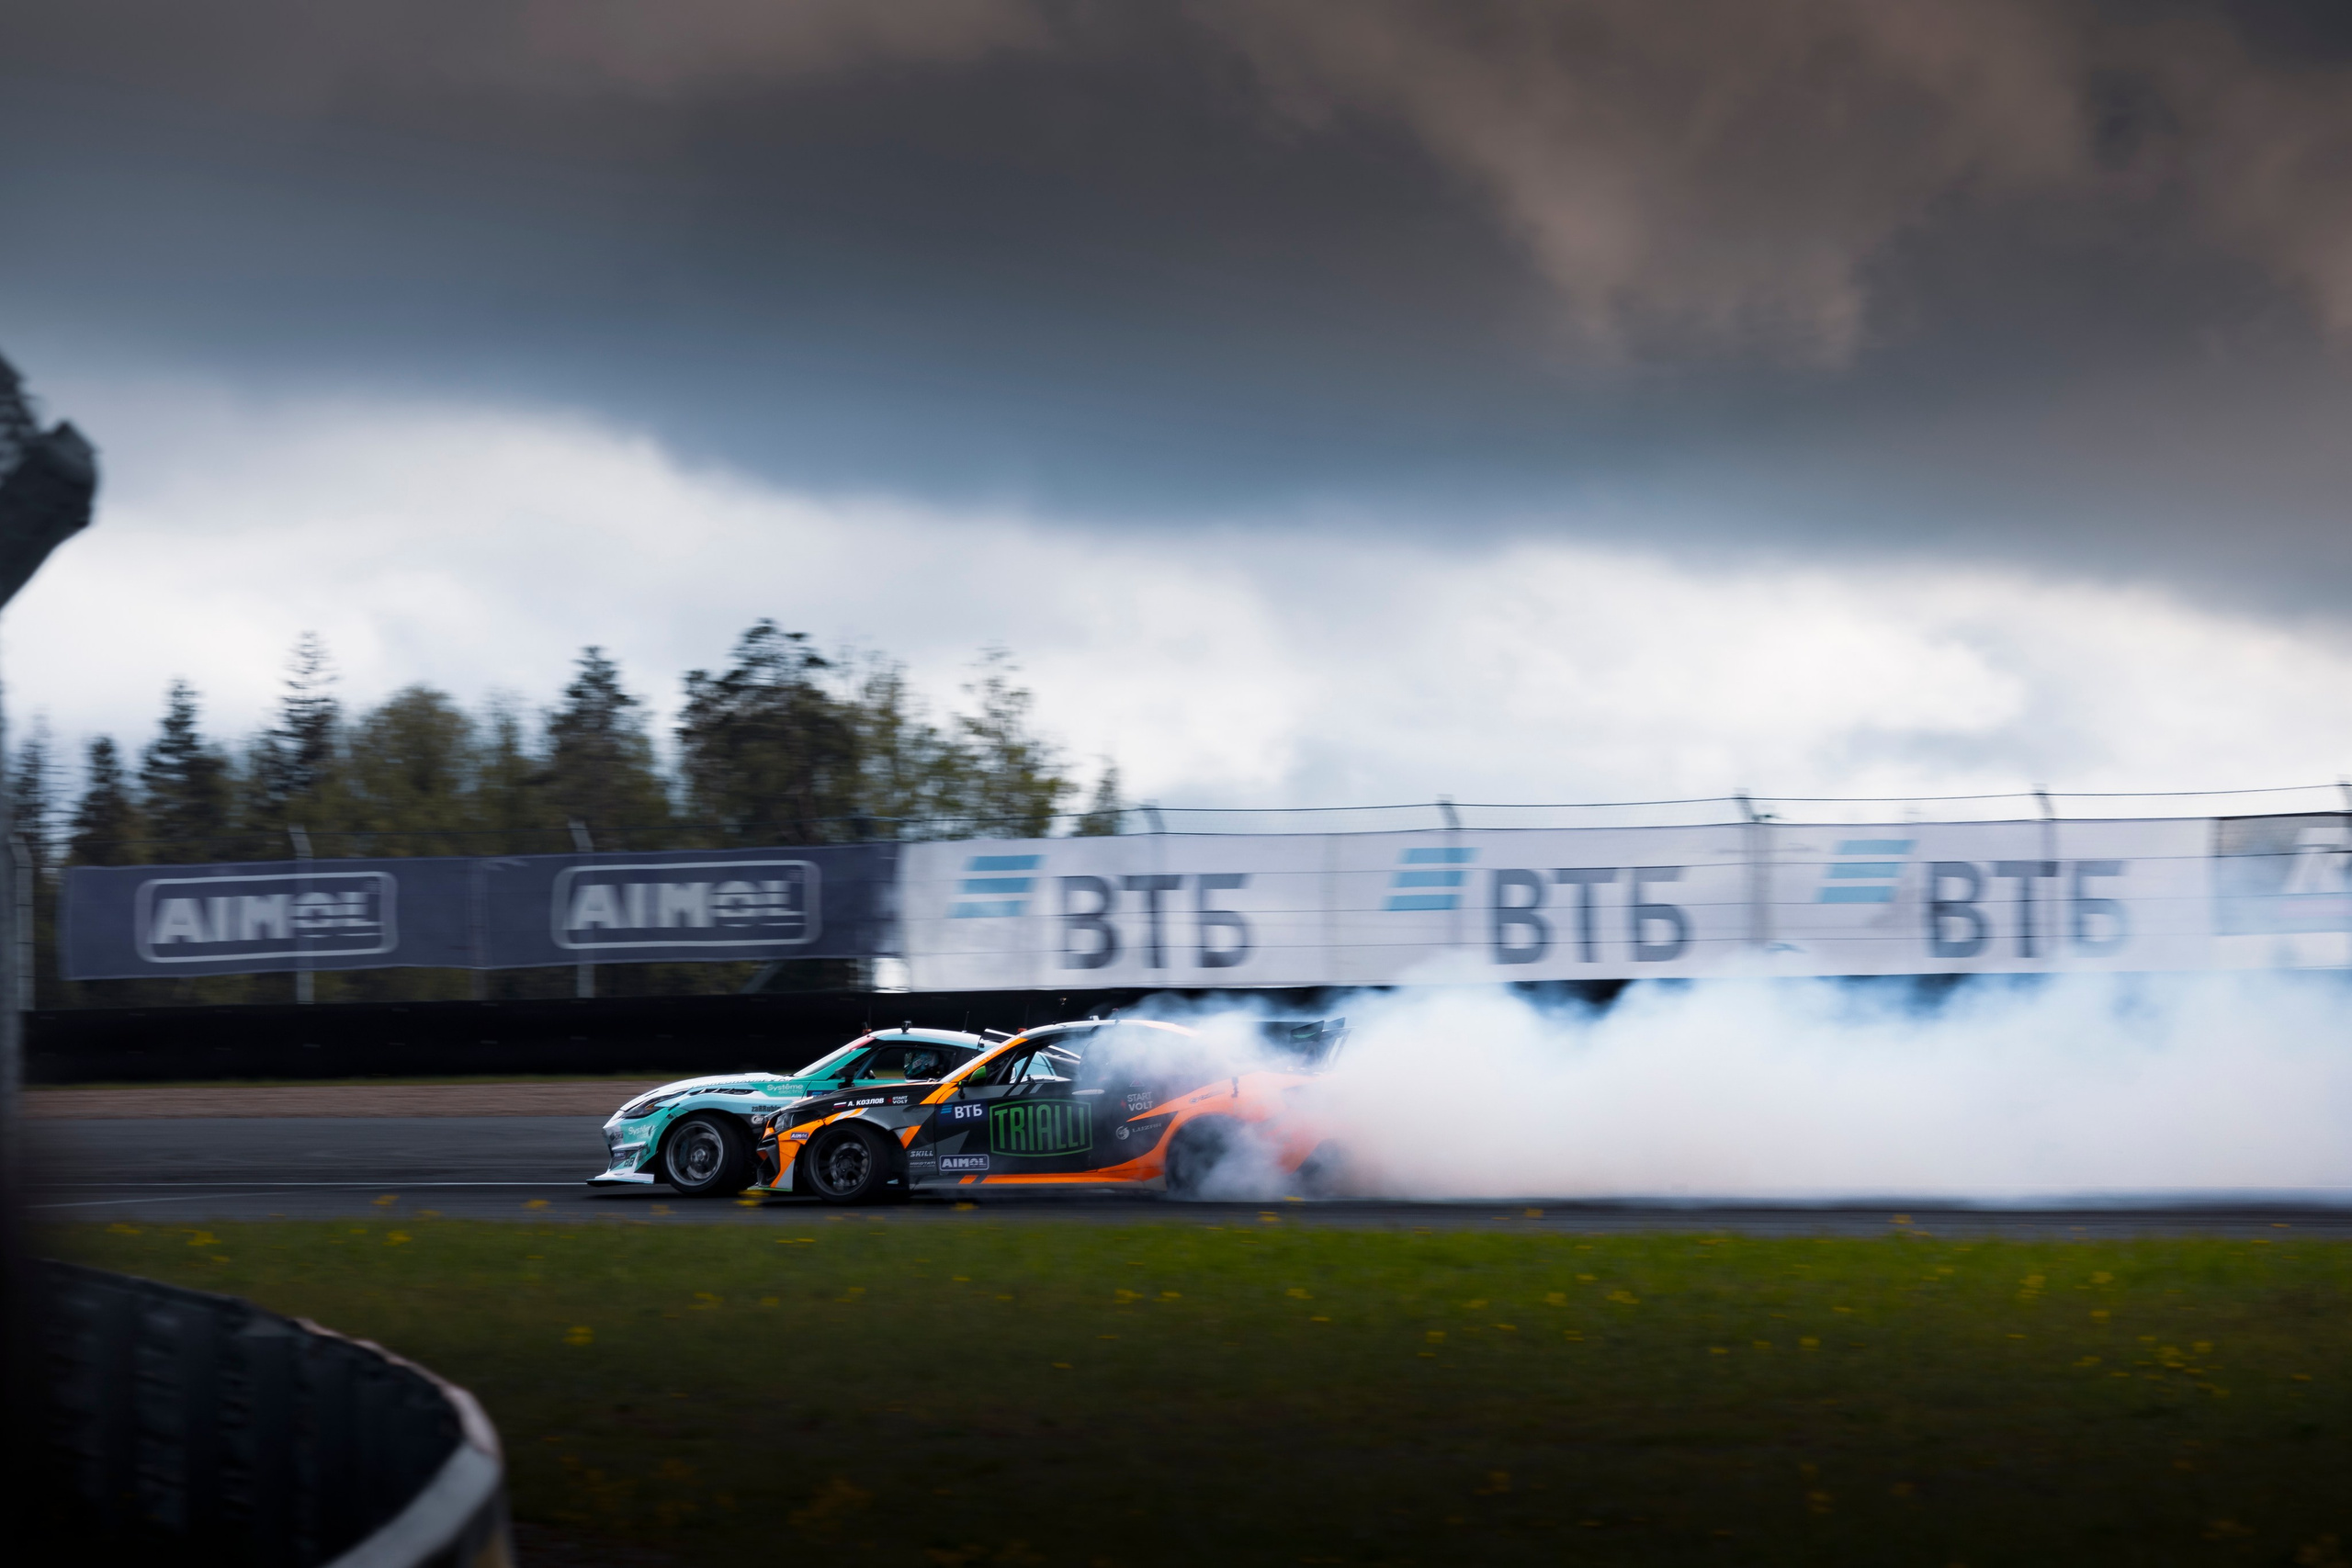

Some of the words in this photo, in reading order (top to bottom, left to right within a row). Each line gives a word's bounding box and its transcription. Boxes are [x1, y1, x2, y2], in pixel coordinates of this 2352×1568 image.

[147, 892, 384, 943] AIMOL
[562, 880, 807, 930] AIMOL
[1058, 874, 1257, 970] ВТБ
[1487, 867, 1695, 964] ВТБ
[1922, 861, 2132, 958] ВТБ
[856, 1098, 884, 1106] КОЗЛОВ
[955, 1104, 983, 1119] ВТБ
[1127, 1091, 1152, 1102] START
[1128, 1100, 1153, 1111] VOLT
[994, 1104, 1085, 1151] TRIALLI
[942, 1158, 987, 1168] AIMOL
